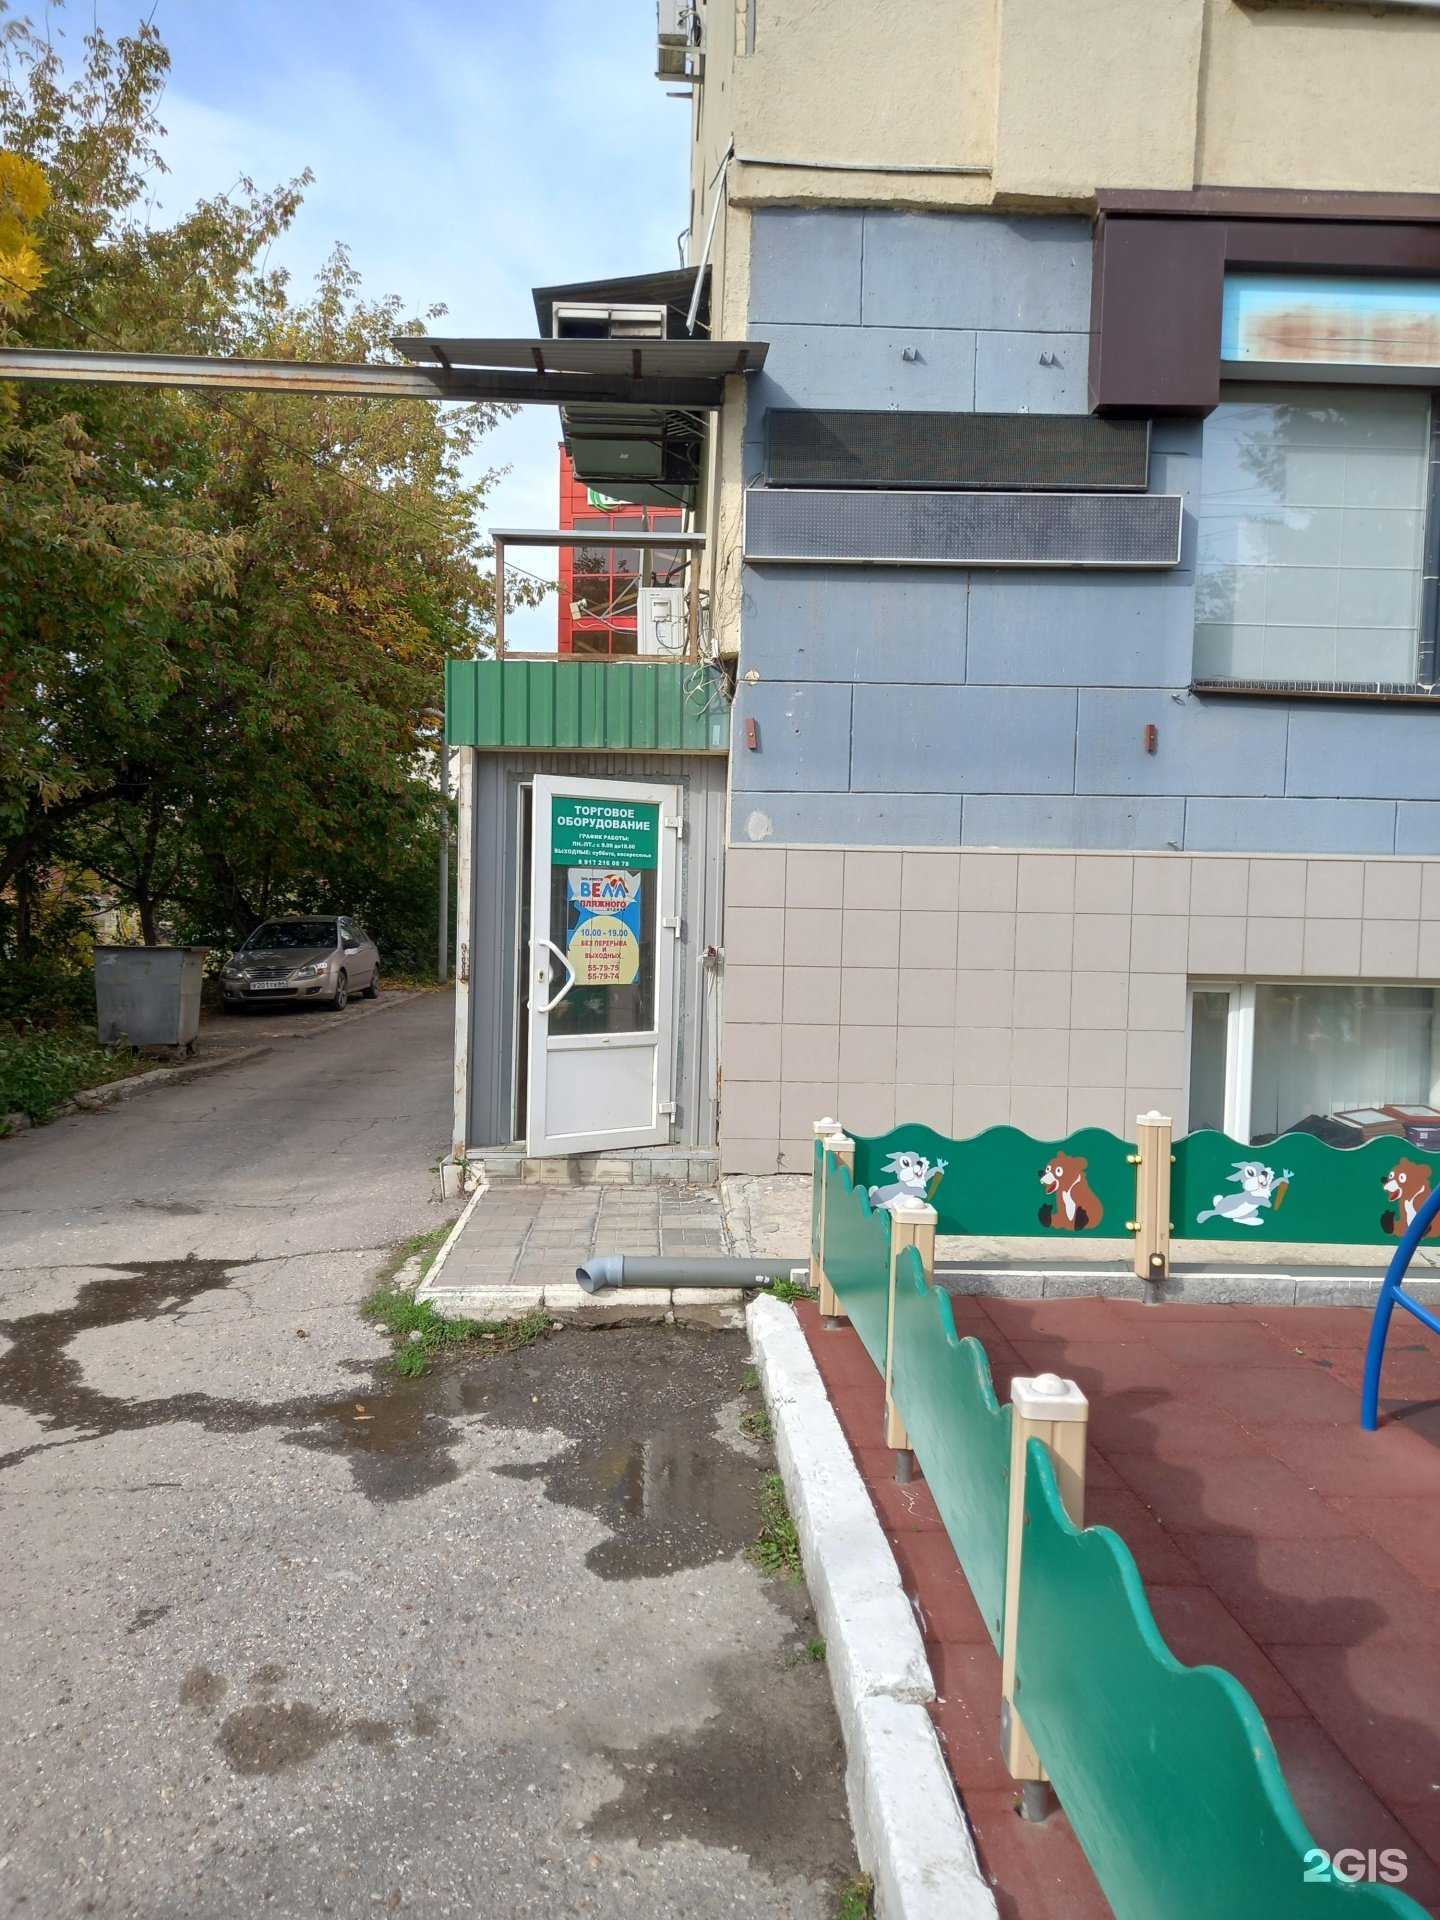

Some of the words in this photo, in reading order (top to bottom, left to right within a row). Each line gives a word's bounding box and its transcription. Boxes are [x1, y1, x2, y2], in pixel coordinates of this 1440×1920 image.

[574, 805, 635, 818] ТОРГОВОЕ
[557, 816, 651, 831] ОБОРУДОВАНИЕ
[580, 900, 626, 908] ПЛЯЖНОГО
